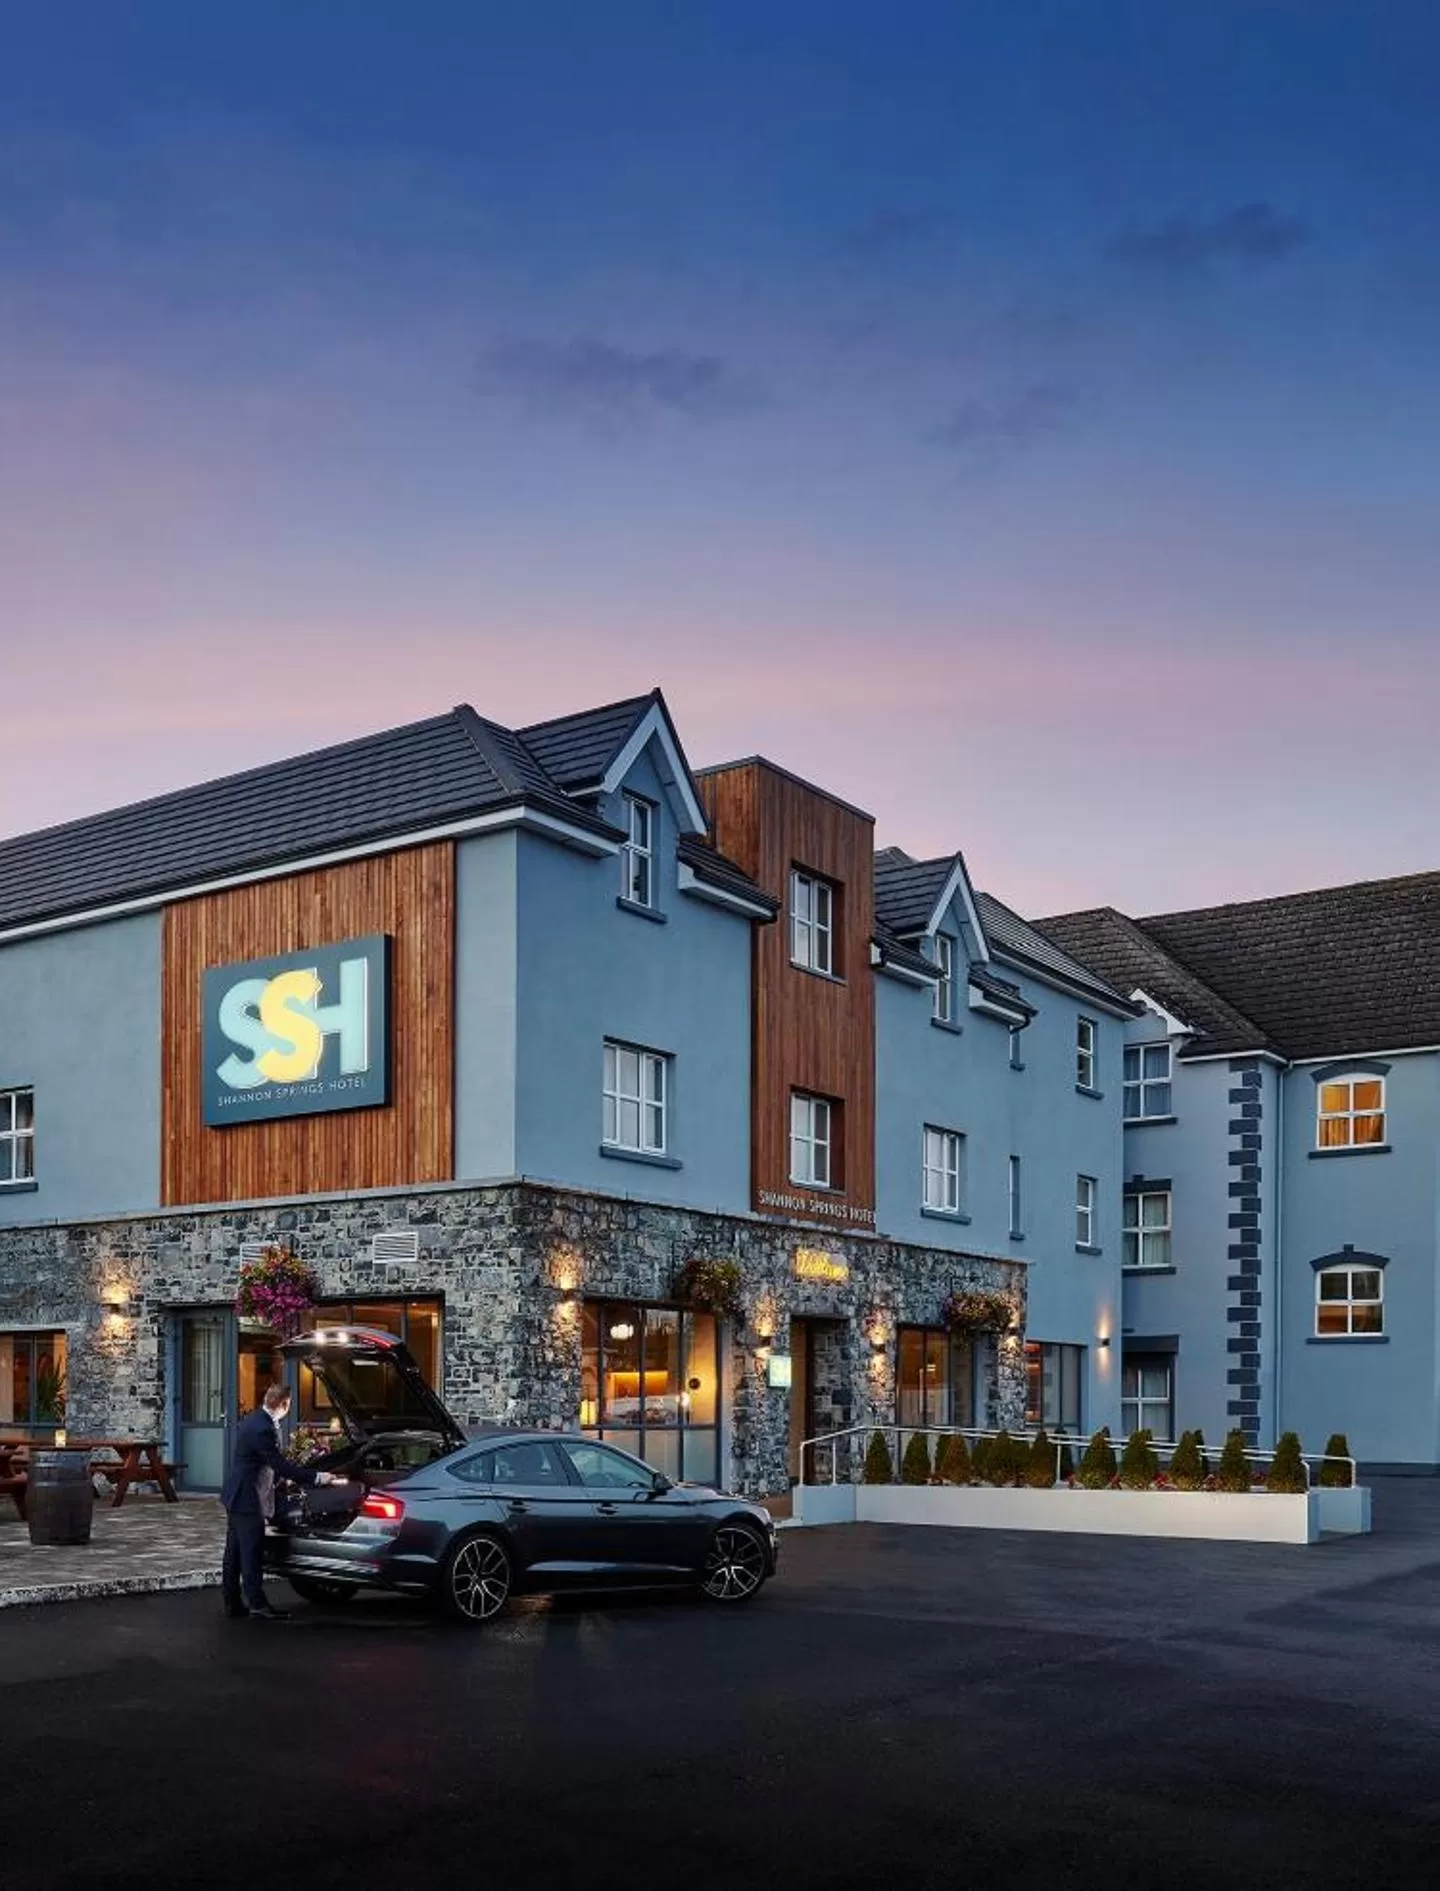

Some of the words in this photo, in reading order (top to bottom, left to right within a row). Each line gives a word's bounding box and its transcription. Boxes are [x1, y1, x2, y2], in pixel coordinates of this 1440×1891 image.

[216, 956, 367, 1089] SSH
[218, 1089, 272, 1107] SHANNON
[276, 1081, 324, 1099] SPRINGS
[329, 1077, 366, 1092] HOTEL
[759, 1190, 806, 1211] SHANNON
[810, 1200, 848, 1219] SPRINGS
[850, 1207, 877, 1225] HOTEL
